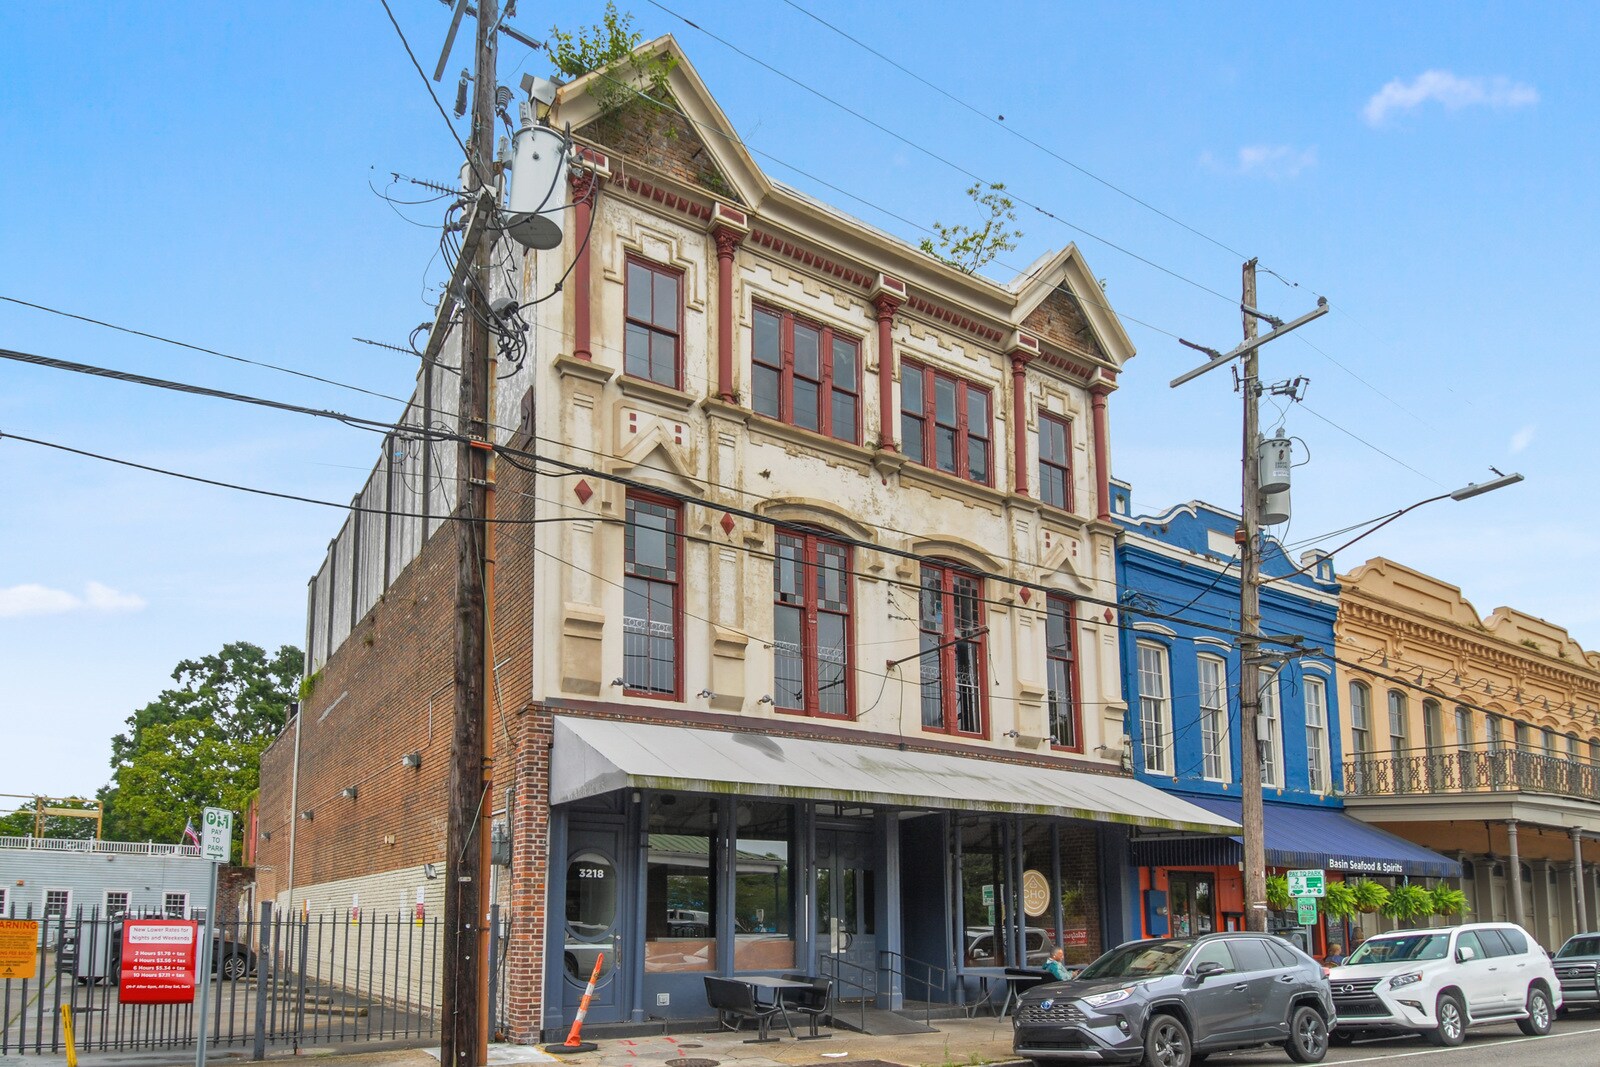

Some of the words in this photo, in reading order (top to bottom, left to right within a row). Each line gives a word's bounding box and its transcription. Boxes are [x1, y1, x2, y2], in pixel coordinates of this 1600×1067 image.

[1329, 858, 1348, 869] Basin
[1349, 860, 1375, 871] Seafood
[1376, 862, 1382, 871] &
[1382, 863, 1403, 874] Spirits
[579, 868, 604, 878] 3218
